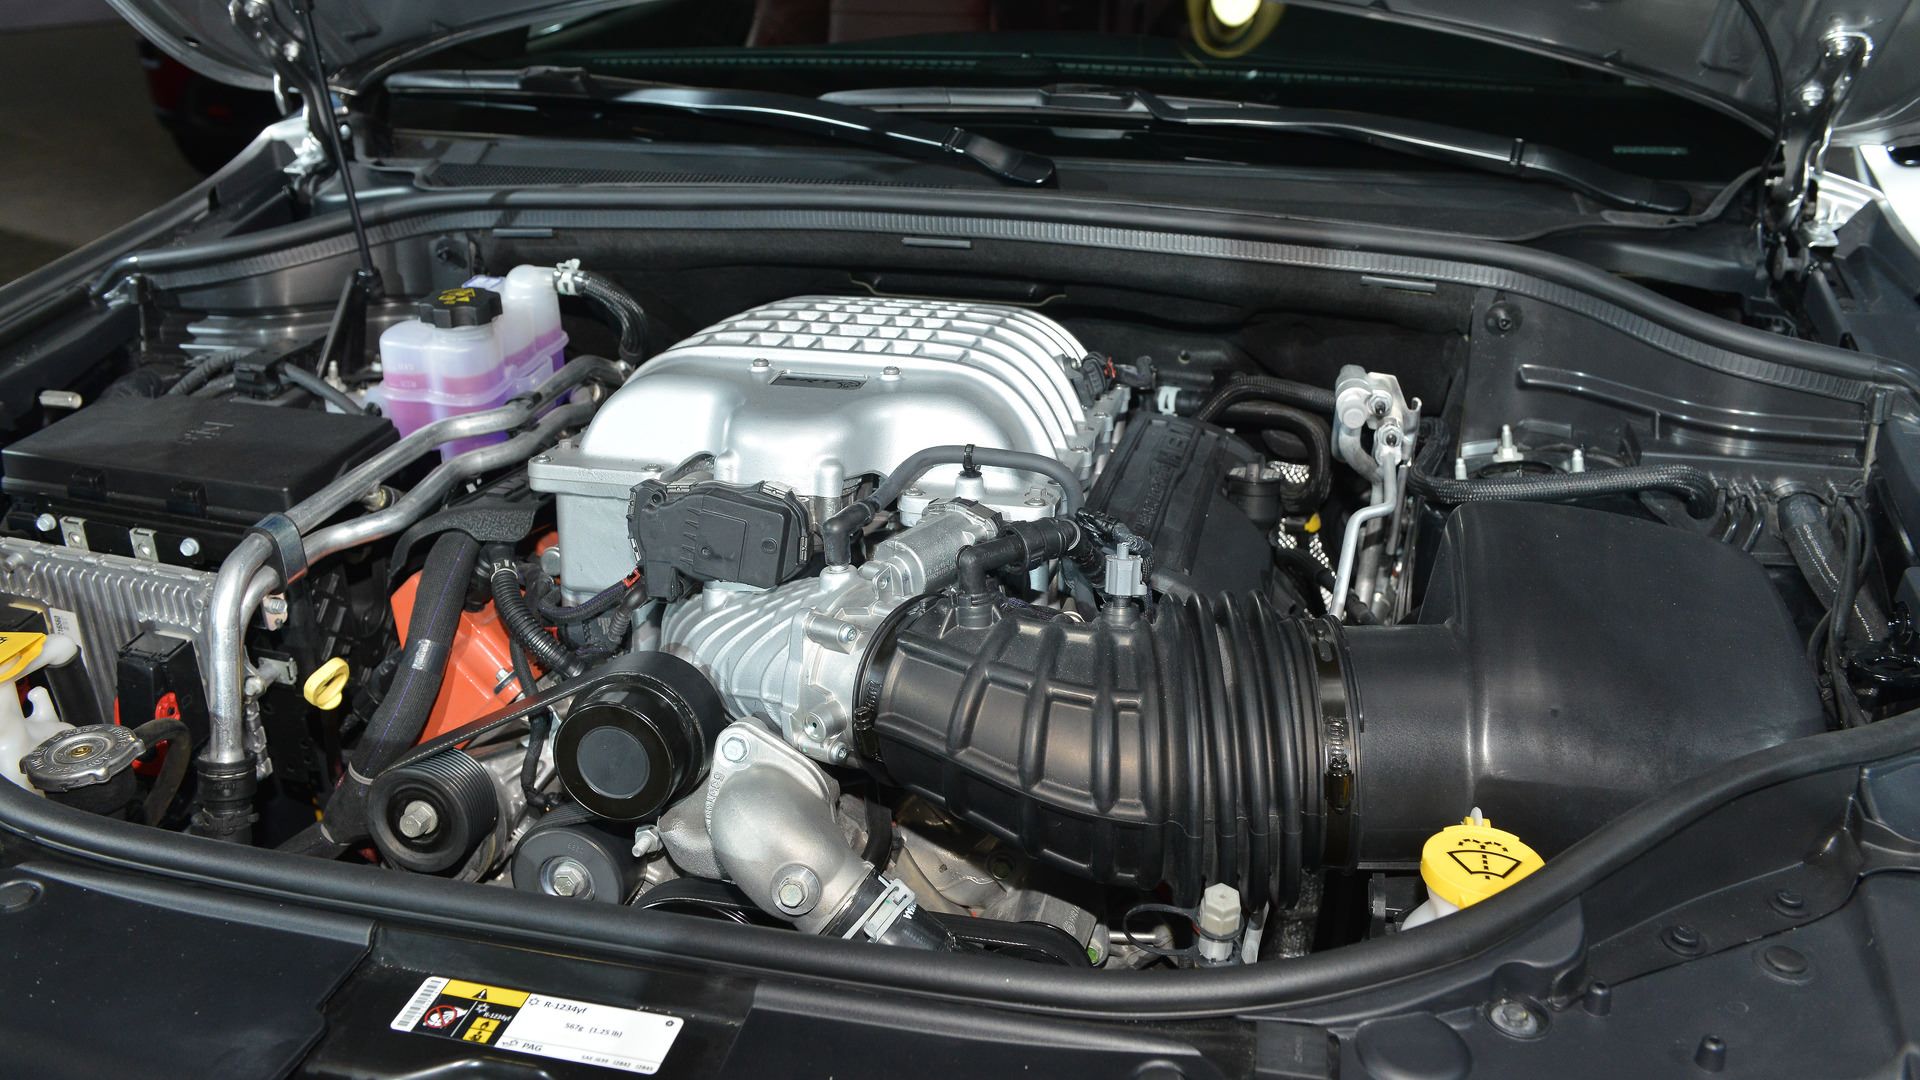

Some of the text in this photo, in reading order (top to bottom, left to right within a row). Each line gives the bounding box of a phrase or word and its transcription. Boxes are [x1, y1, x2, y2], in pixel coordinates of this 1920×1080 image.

[544, 1001, 588, 1014] R-1234yf
[565, 1022, 623, 1039] 567g (1.25 lb)
[522, 1042, 543, 1053] PAG
